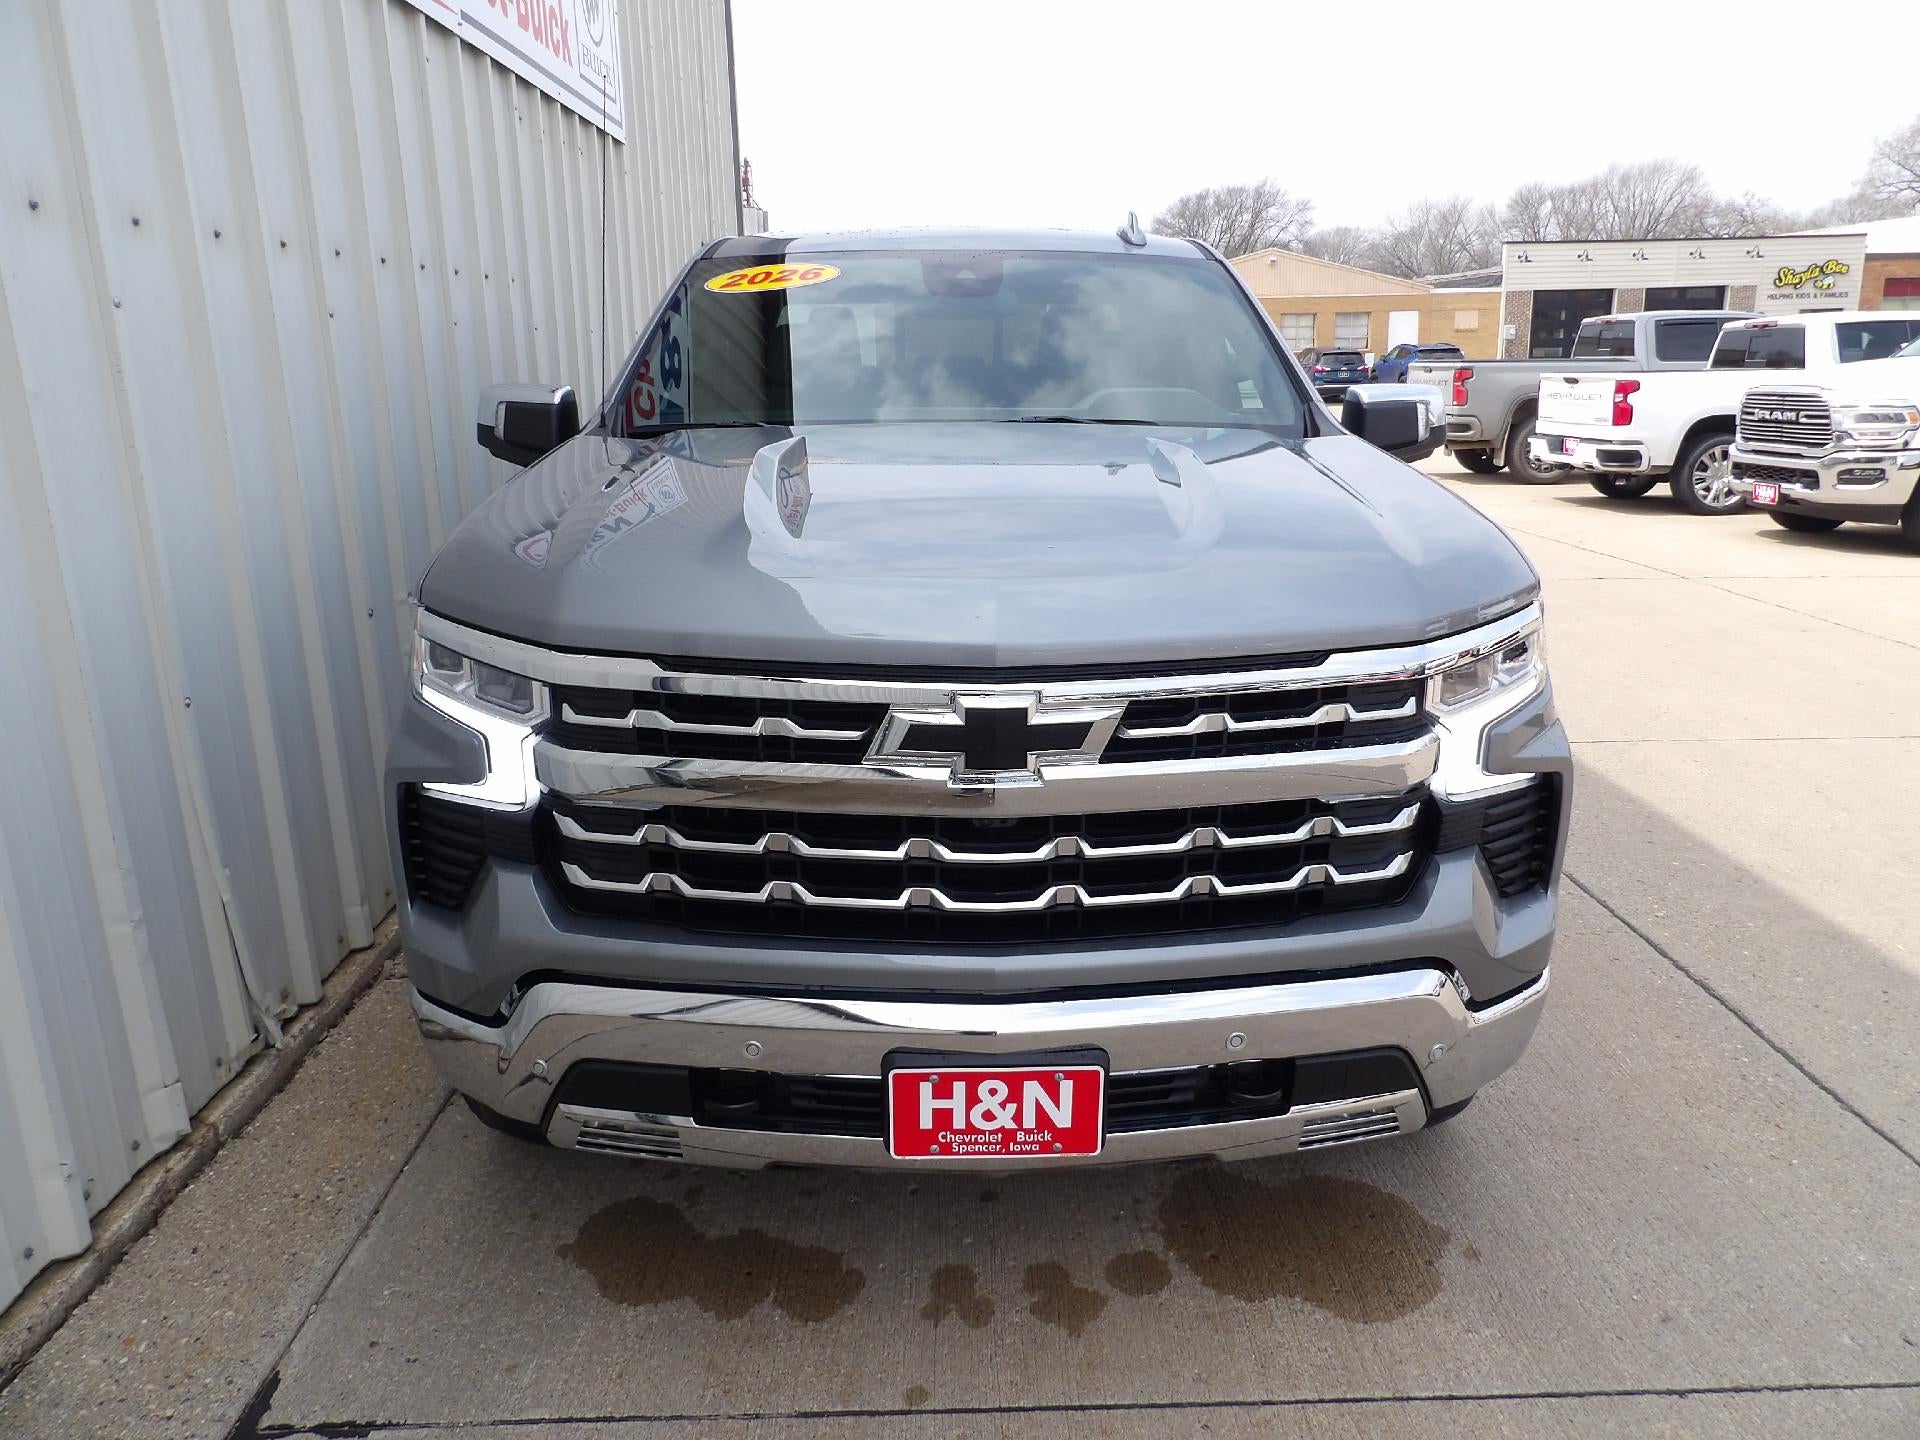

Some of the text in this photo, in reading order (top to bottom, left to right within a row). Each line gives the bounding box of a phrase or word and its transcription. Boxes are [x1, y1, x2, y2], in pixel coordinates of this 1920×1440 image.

[719, 267, 826, 289] 2026
[1774, 259, 1850, 289] Shayla Bee
[1766, 292, 1794, 300] HELPING
[1758, 405, 1797, 421] RAM
[919, 1079, 1074, 1131] H&N
[938, 1129, 1052, 1143] Chevrolet Buick
[952, 1142, 1040, 1154] Spencer, Iowa
